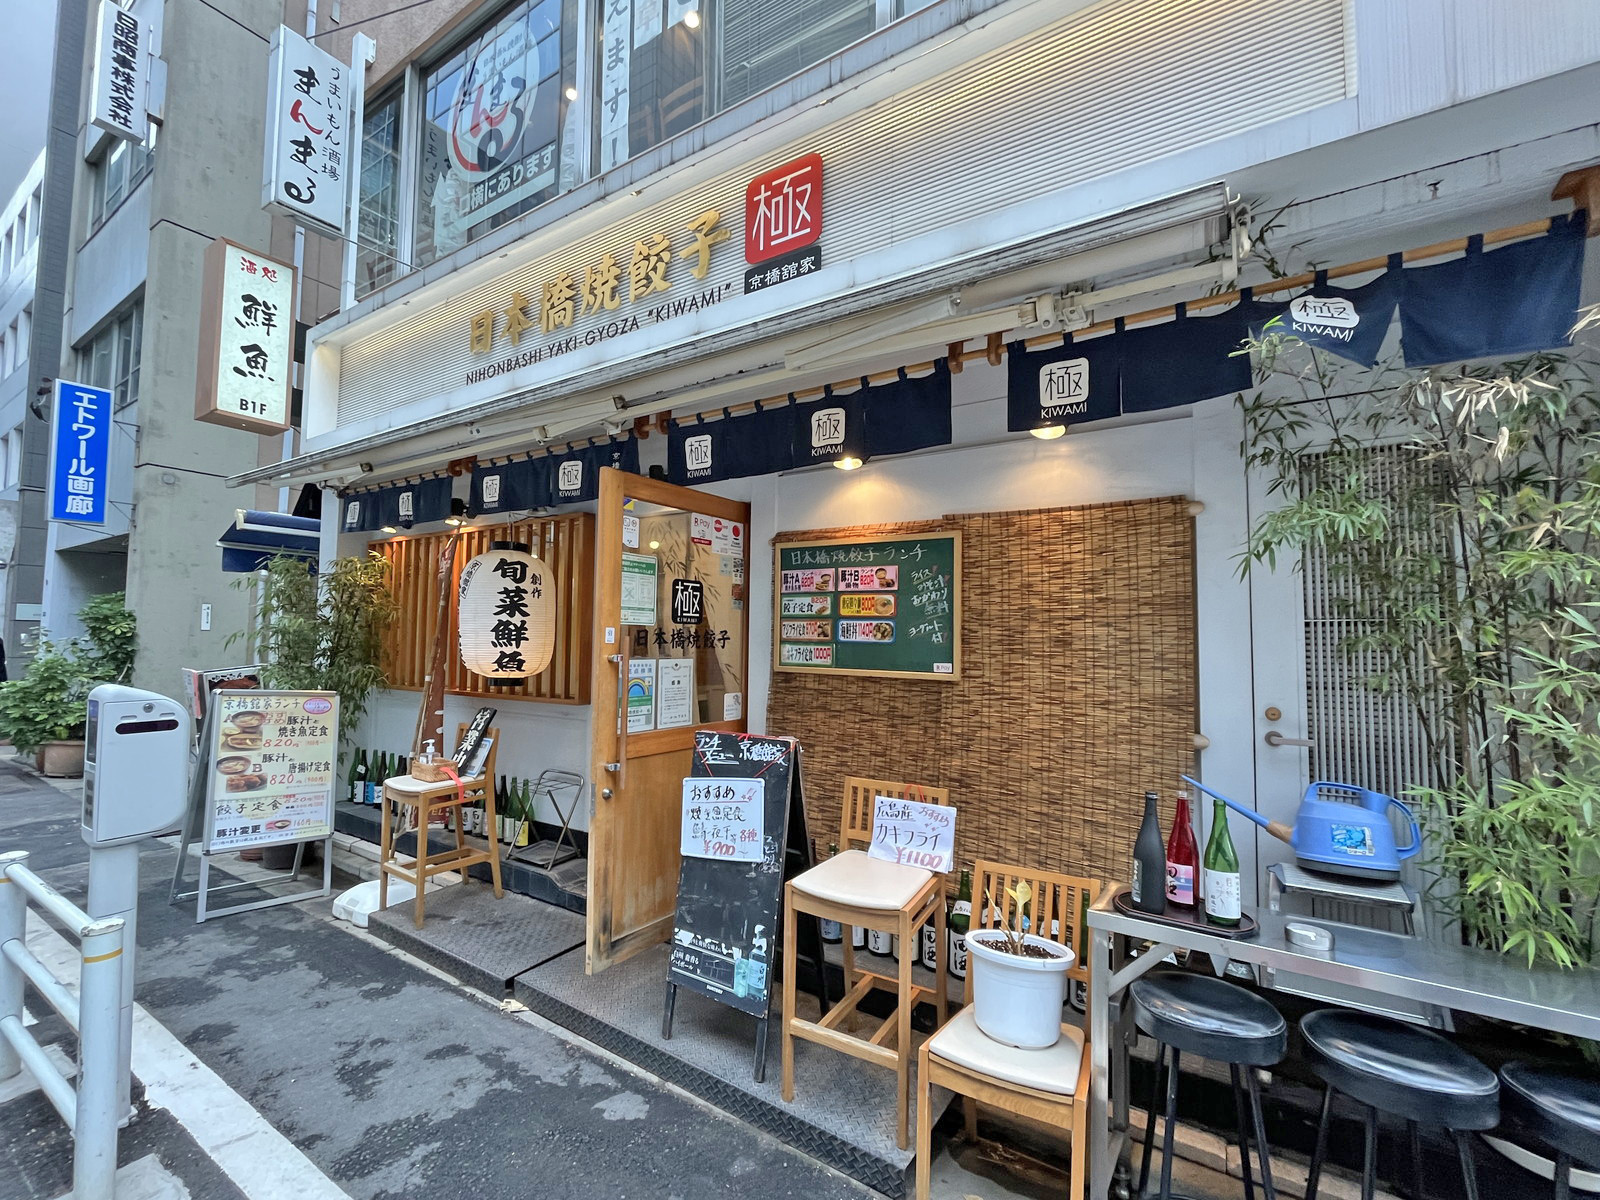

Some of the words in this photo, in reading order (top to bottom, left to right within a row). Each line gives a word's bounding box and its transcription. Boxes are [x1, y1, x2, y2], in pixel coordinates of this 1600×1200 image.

[108, 10, 139, 130] 日昭商事株式会社
[283, 65, 324, 205] まんまる
[321, 65, 342, 182] うまいもん酒場
[752, 166, 812, 251] 極
[240, 256, 279, 284] 酒処
[469, 210, 732, 356] 日本橋焼餃子
[748, 256, 816, 290] 京橋舘家
[232, 294, 278, 382] 鮮魚
[1292, 322, 1355, 342] KIWAMI
[465, 347, 544, 386] NIHONBASHI
[547, 315, 640, 360] YAKI-GYOZA
[1044, 364, 1083, 400] 極
[239, 398, 267, 416] B1F
[1040, 402, 1088, 419] KIWAMI
[814, 412, 842, 442] 極
[65, 391, 97, 516] エトワール画廊
[688, 440, 710, 466] 極
[811, 444, 844, 457] KIWAMI
[560, 463, 581, 487] 極
[686, 468, 712, 479] KIWAMI
[530, 573, 542, 599] 創作
[674, 581, 701, 617] 極
[490, 558, 531, 673] 旬菜鮮魚
[783, 603, 814, 613] 餃子定食
[634, 627, 731, 650] 日本橋焼餃子
[278, 725, 329, 738] 焼き魚定食
[288, 761, 331, 774] 唐揚げ定食
[690, 785, 736, 801] おすすめ
[216, 799, 282, 816] 餃子定食
[876, 800, 913, 820] 広島産
[876, 823, 942, 851] カキフライ
[895, 846, 943, 869] ¥1100
